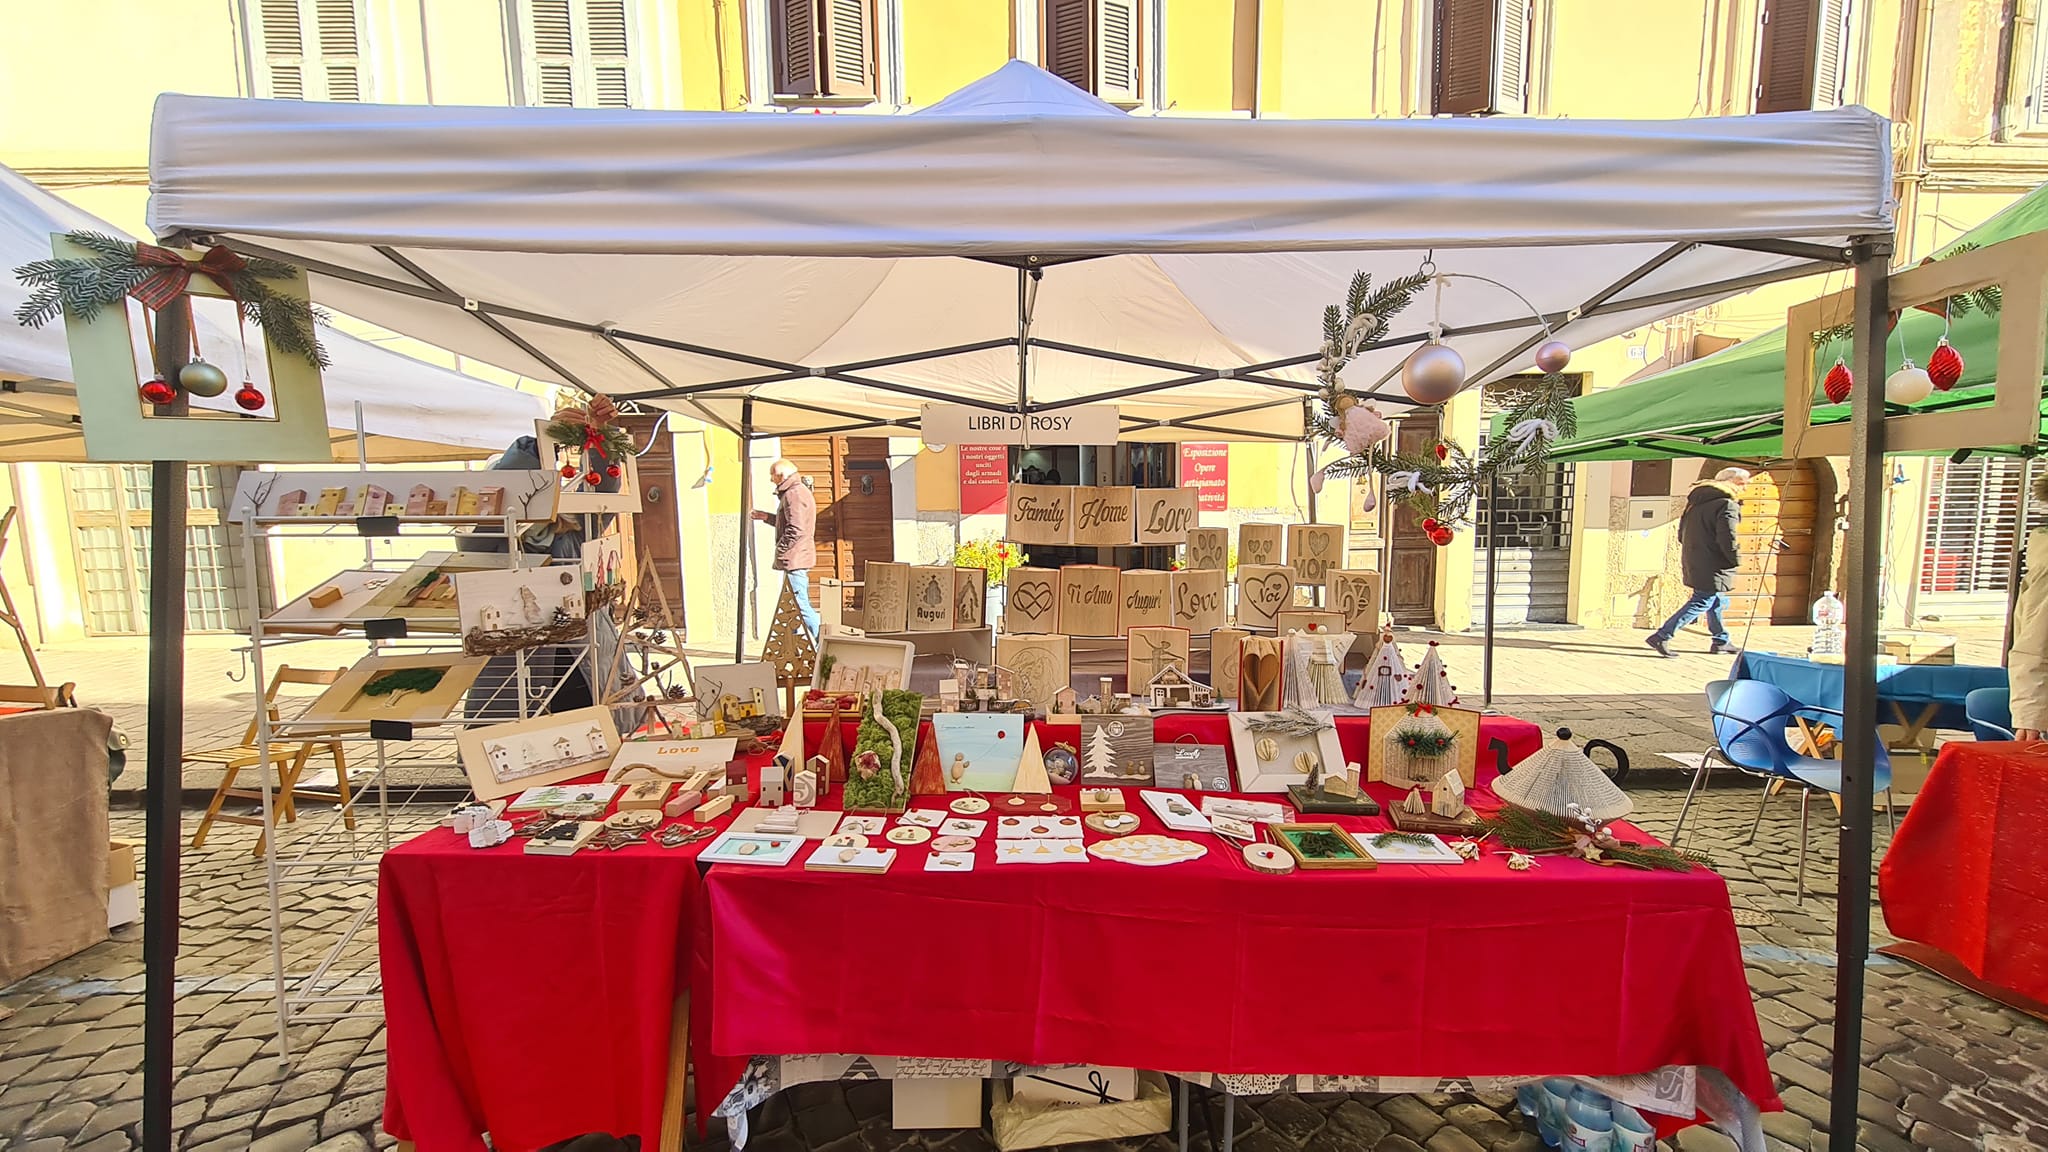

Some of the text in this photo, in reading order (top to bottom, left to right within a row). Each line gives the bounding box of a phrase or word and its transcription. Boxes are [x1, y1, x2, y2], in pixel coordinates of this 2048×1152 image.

[968, 416, 1072, 430] LIBRI D ROSY
[1183, 447, 1227, 460] Esposizione
[1194, 462, 1216, 475] Opere
[1184, 477, 1226, 490] artigianato
[1014, 496, 1065, 532] Family
[1079, 499, 1128, 530] Home
[1144, 500, 1192, 534] Love
[1293, 558, 1336, 579] MOM
[1067, 583, 1113, 605] Ti Amo
[1126, 589, 1162, 615] Auguri
[917, 606, 946, 622] Auguri
[656, 745, 700, 755] Love
